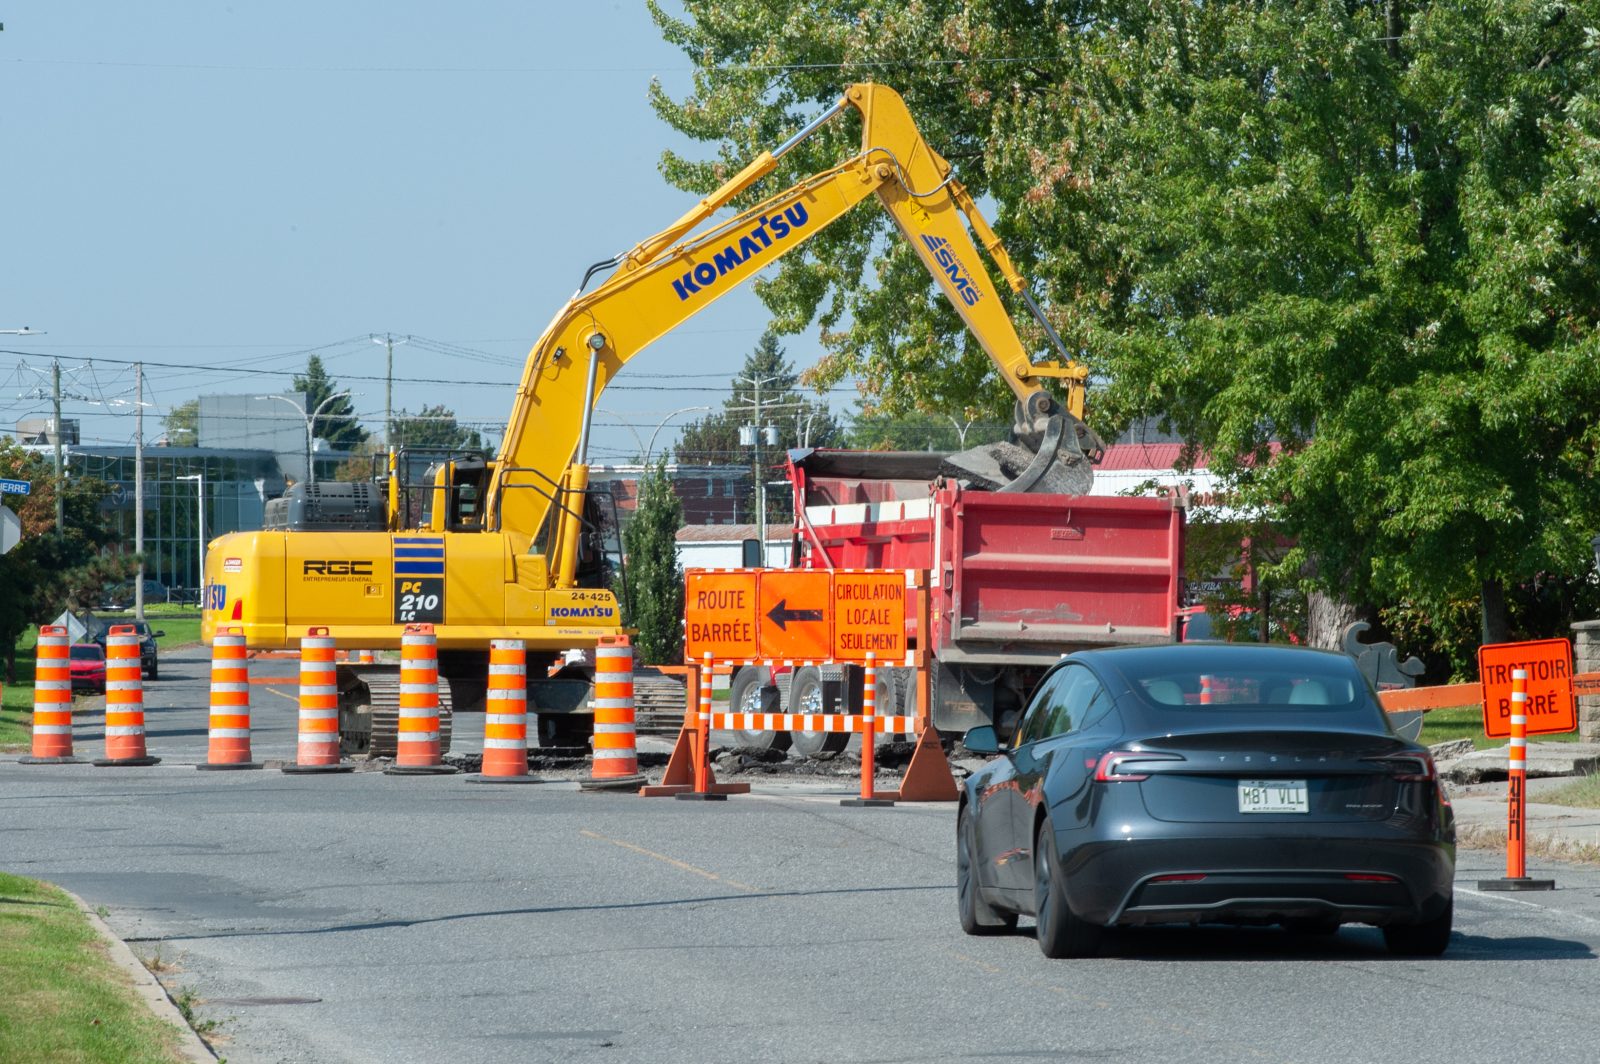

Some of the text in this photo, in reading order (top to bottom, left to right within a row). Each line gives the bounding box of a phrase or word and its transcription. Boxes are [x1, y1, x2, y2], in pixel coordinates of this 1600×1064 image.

[672, 201, 809, 301] KOMATSU
[945, 243, 985, 298] EQUIPMENT
[303, 560, 373, 576] RGC
[400, 582, 422, 593] PC
[836, 583, 902, 601] CIRCULATION
[400, 594, 439, 611] 210
[571, 592, 611, 601] 24-425
[697, 590, 745, 609] ROUTE
[400, 611, 415, 621] LC
[551, 605, 613, 617] KOMATSU
[847, 608, 890, 625] LOCALE
[691, 618, 752, 643] BARRÉE
[840, 633, 898, 650] SEULEMENT
[1499, 689, 1559, 718] BRRÉ
[1218, 755, 1327, 763] TESLA
[1243, 787, 1305, 805] M81 VLL
